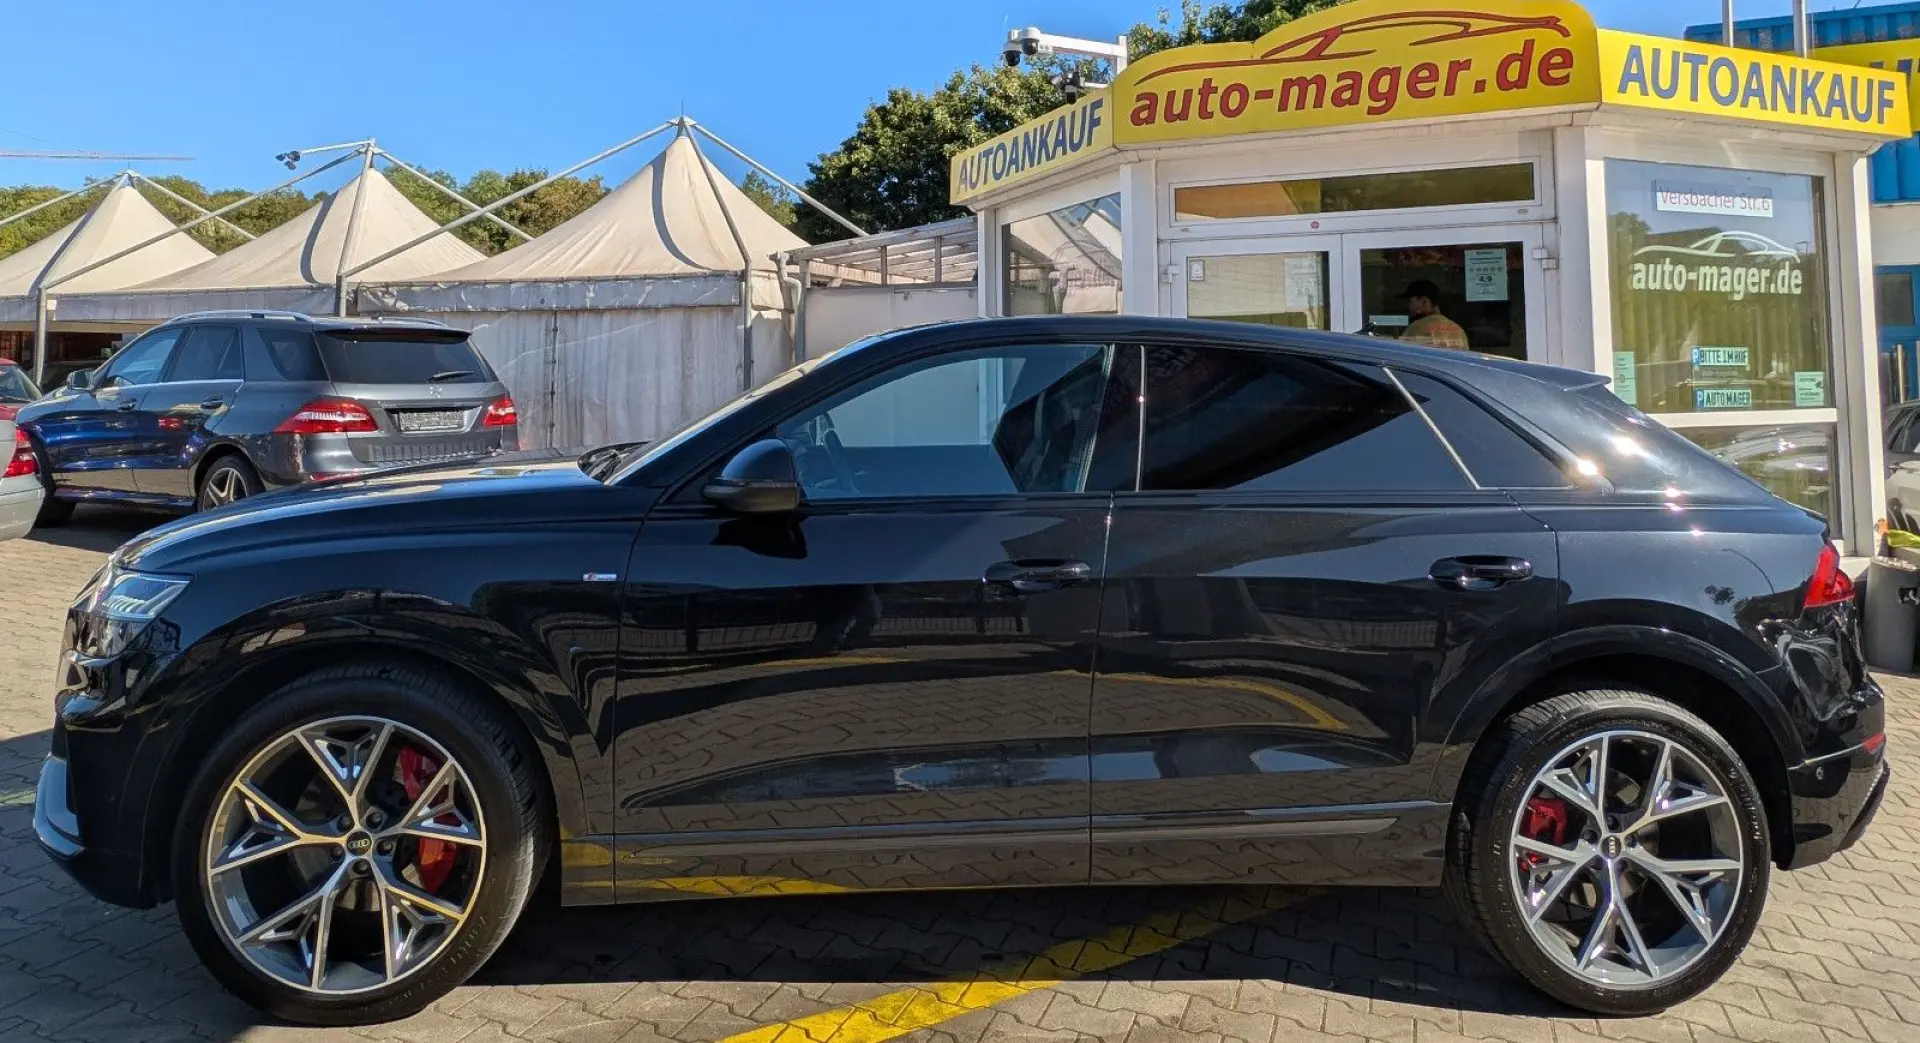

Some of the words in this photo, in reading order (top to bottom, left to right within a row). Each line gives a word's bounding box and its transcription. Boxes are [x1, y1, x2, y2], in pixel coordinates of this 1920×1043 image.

[1130, 39, 1574, 126] auto-mager.de
[1618, 45, 1896, 124] AUTOANKAUF
[955, 98, 1104, 196] AUTOANKAUF
[1660, 187, 1735, 208] Versbacher
[1632, 257, 1803, 301] auto-mager.de
[1700, 350, 1721, 363] BITTE
[1706, 392, 1725, 406] AUTO
[1726, 392, 1751, 406] MAGER
